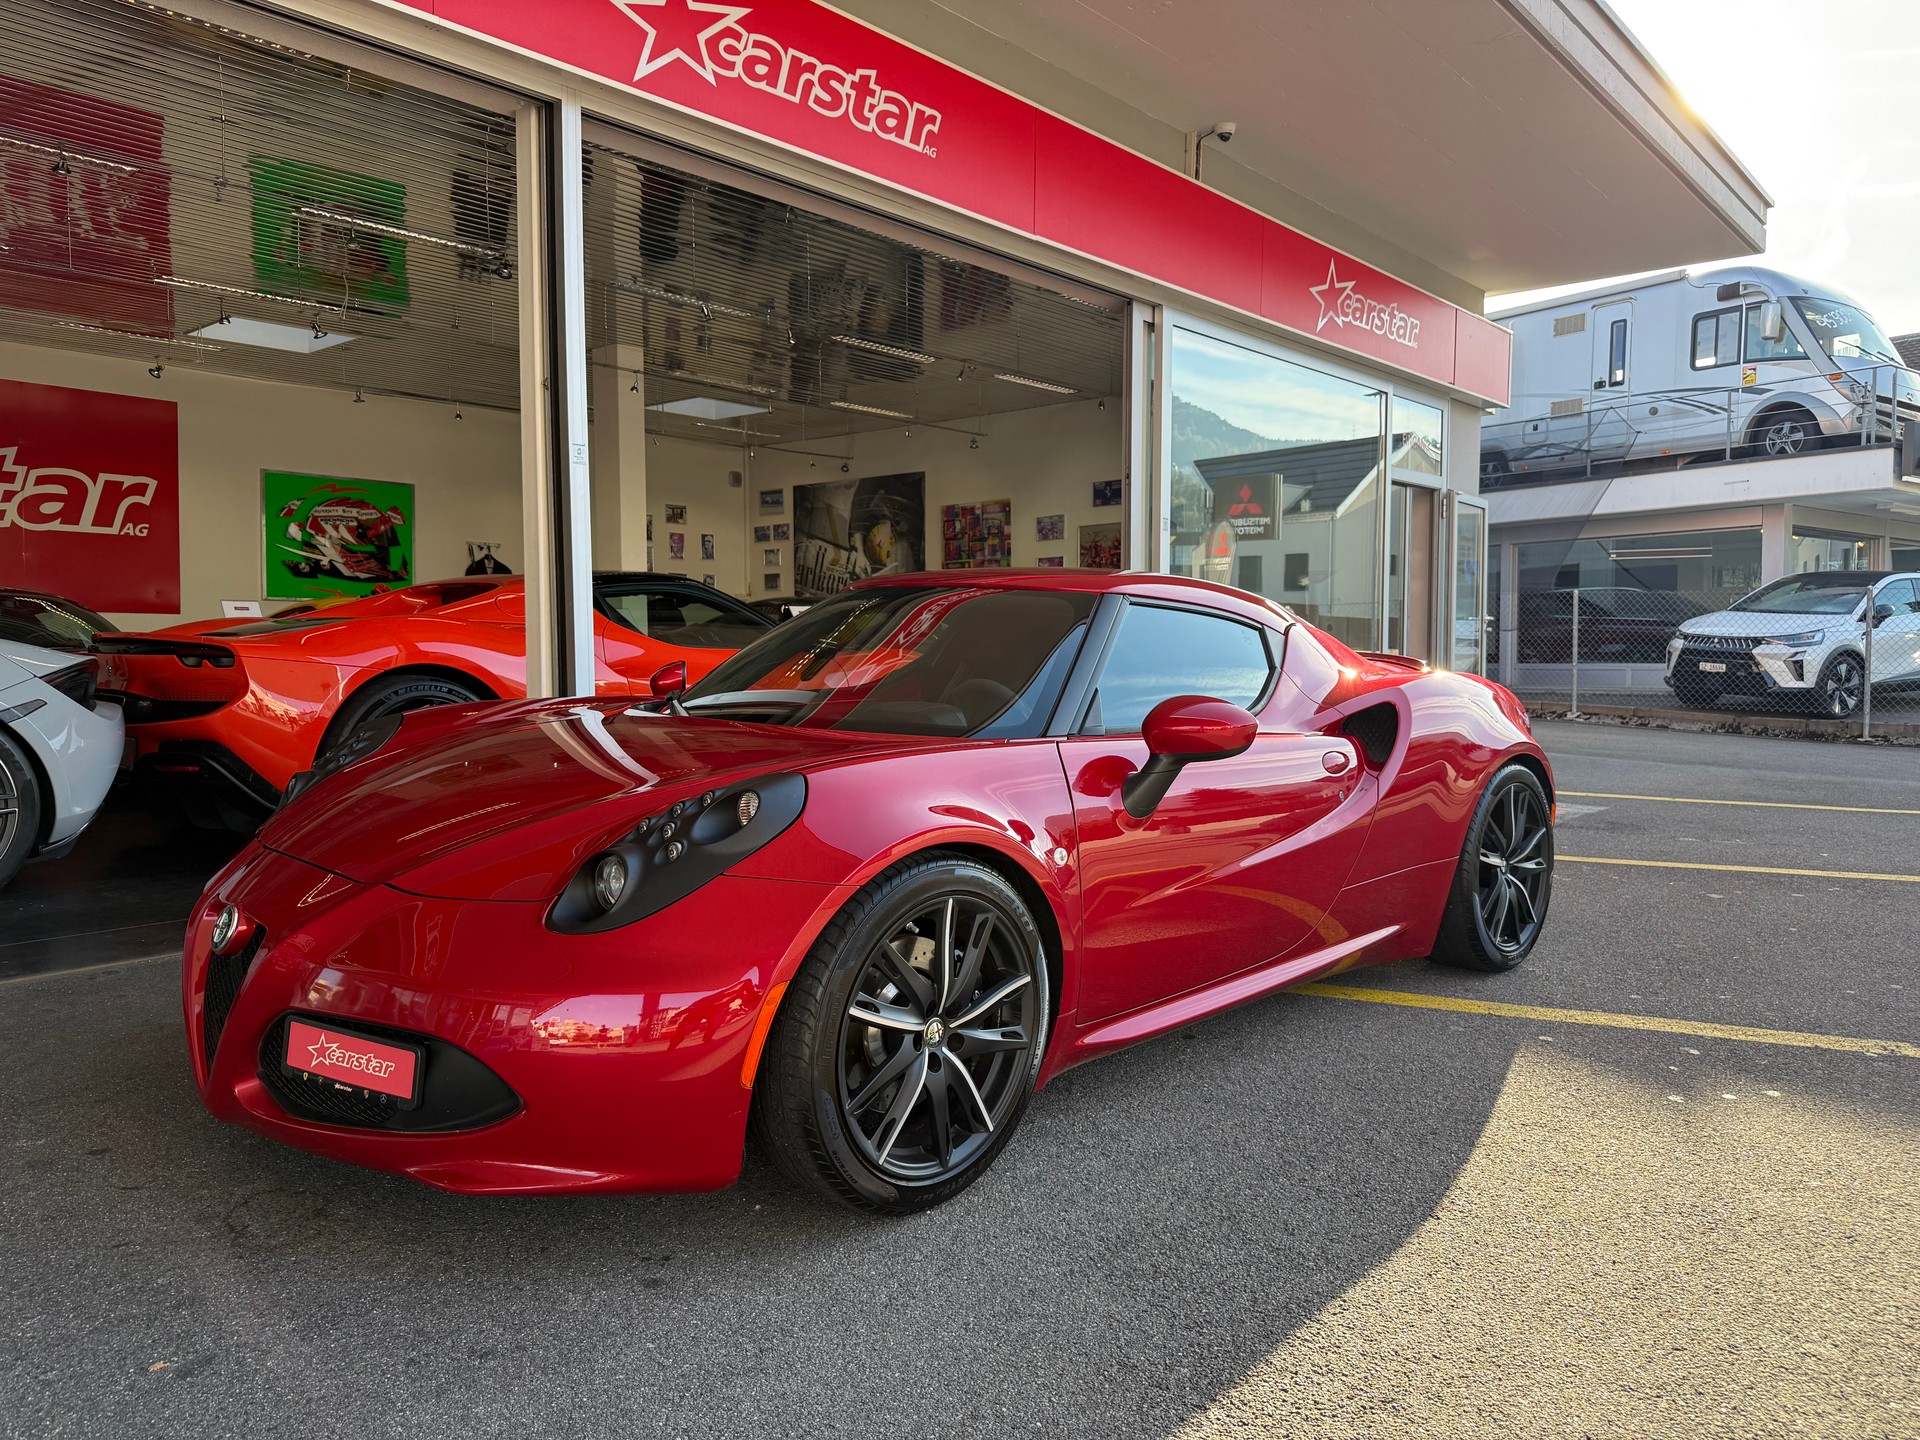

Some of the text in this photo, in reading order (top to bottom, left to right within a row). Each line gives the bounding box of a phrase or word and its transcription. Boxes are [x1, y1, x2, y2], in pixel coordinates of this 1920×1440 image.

[701, 22, 942, 158] carstar AG
[1338, 290, 1420, 347] carstar
[119, 523, 149, 537] AG
[397, 685, 449, 695] MICHELIN
[325, 1048, 395, 1078] carstar
[831, 1150, 858, 1184] OUTSIDE
